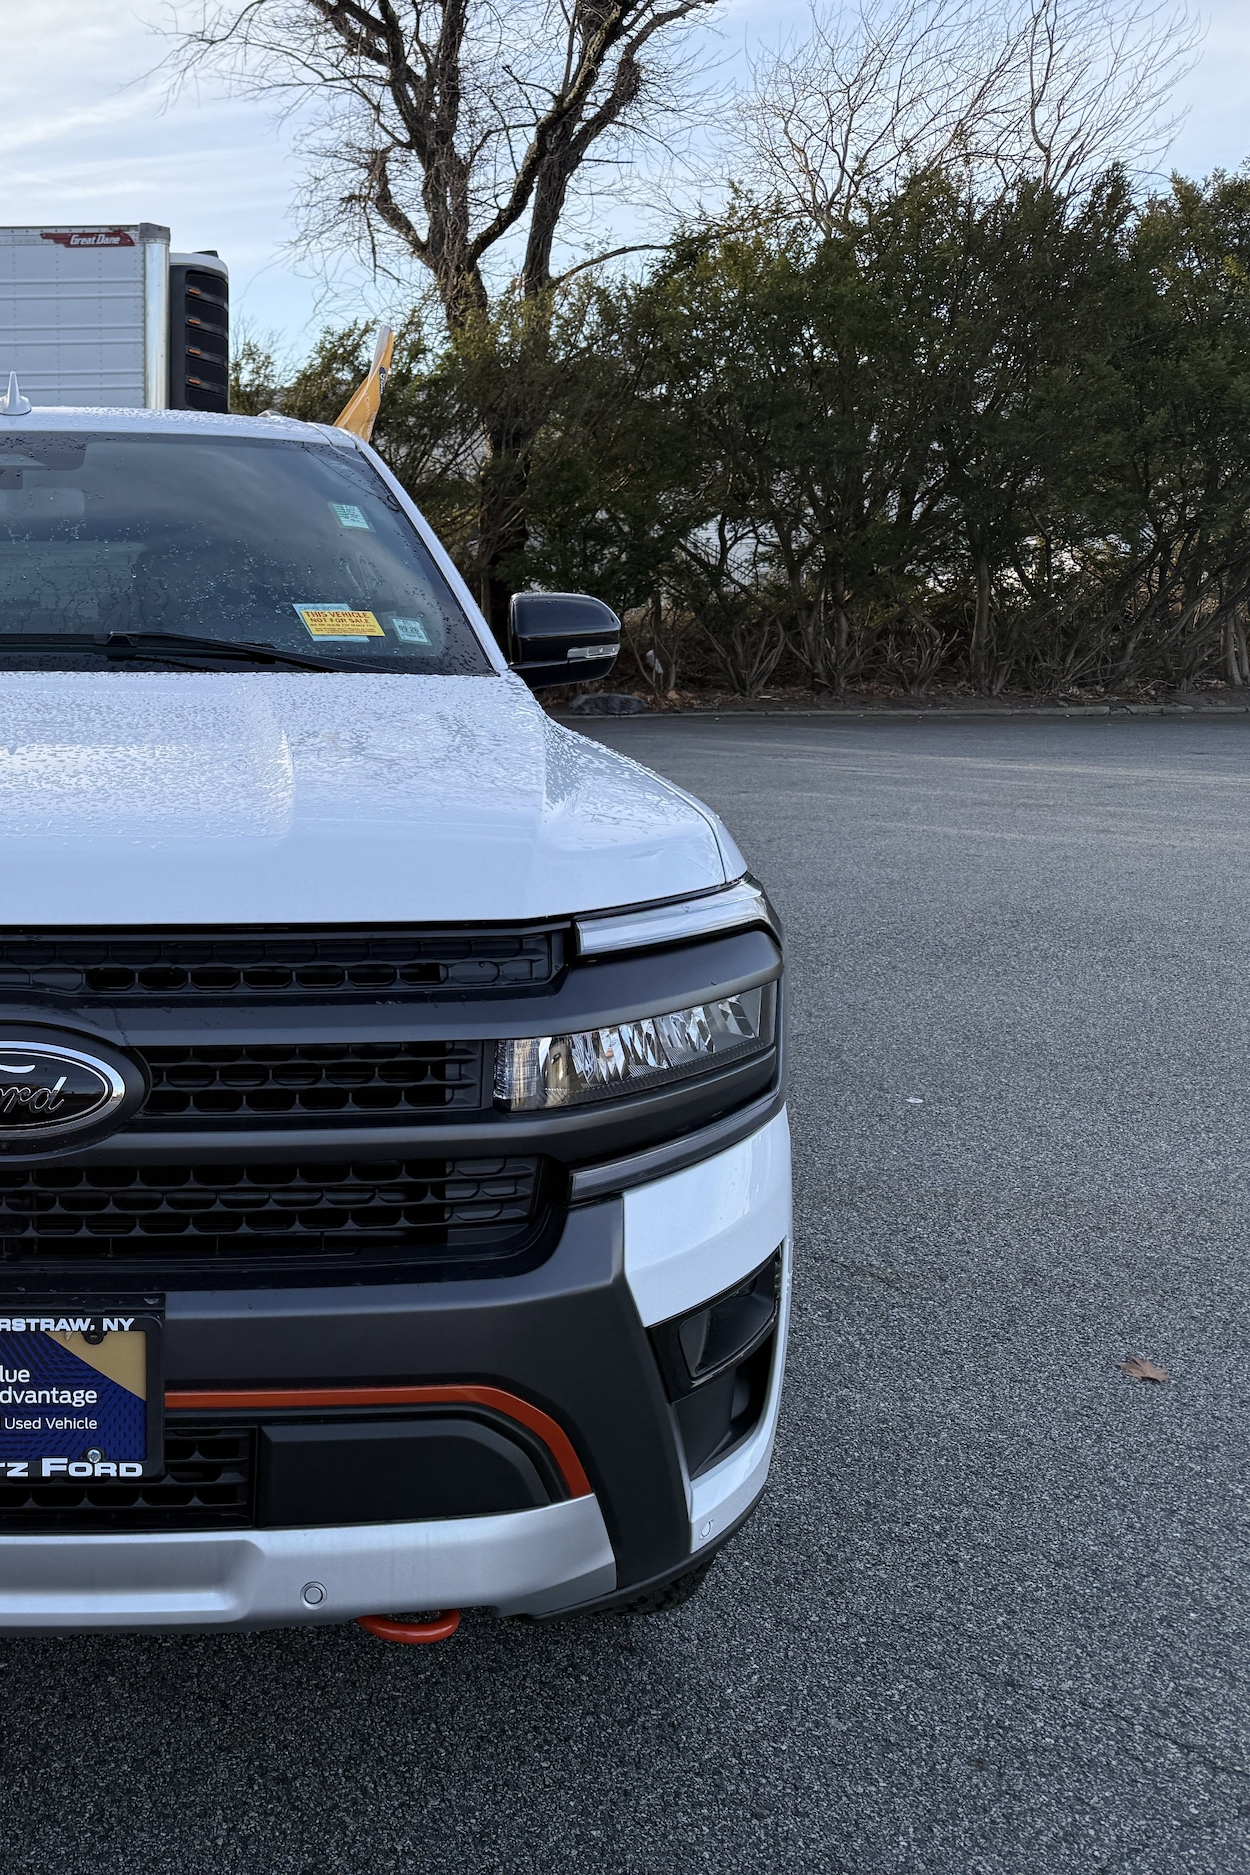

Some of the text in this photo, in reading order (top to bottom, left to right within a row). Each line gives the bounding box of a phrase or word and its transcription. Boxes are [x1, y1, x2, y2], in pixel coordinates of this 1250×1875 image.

[70, 234, 121, 245] Great Dane
[102, 1318, 135, 1332] NY
[4, 1417, 41, 1430] Used
[46, 1417, 98, 1430] Vehicle
[41, 1458, 143, 1477] FORD
